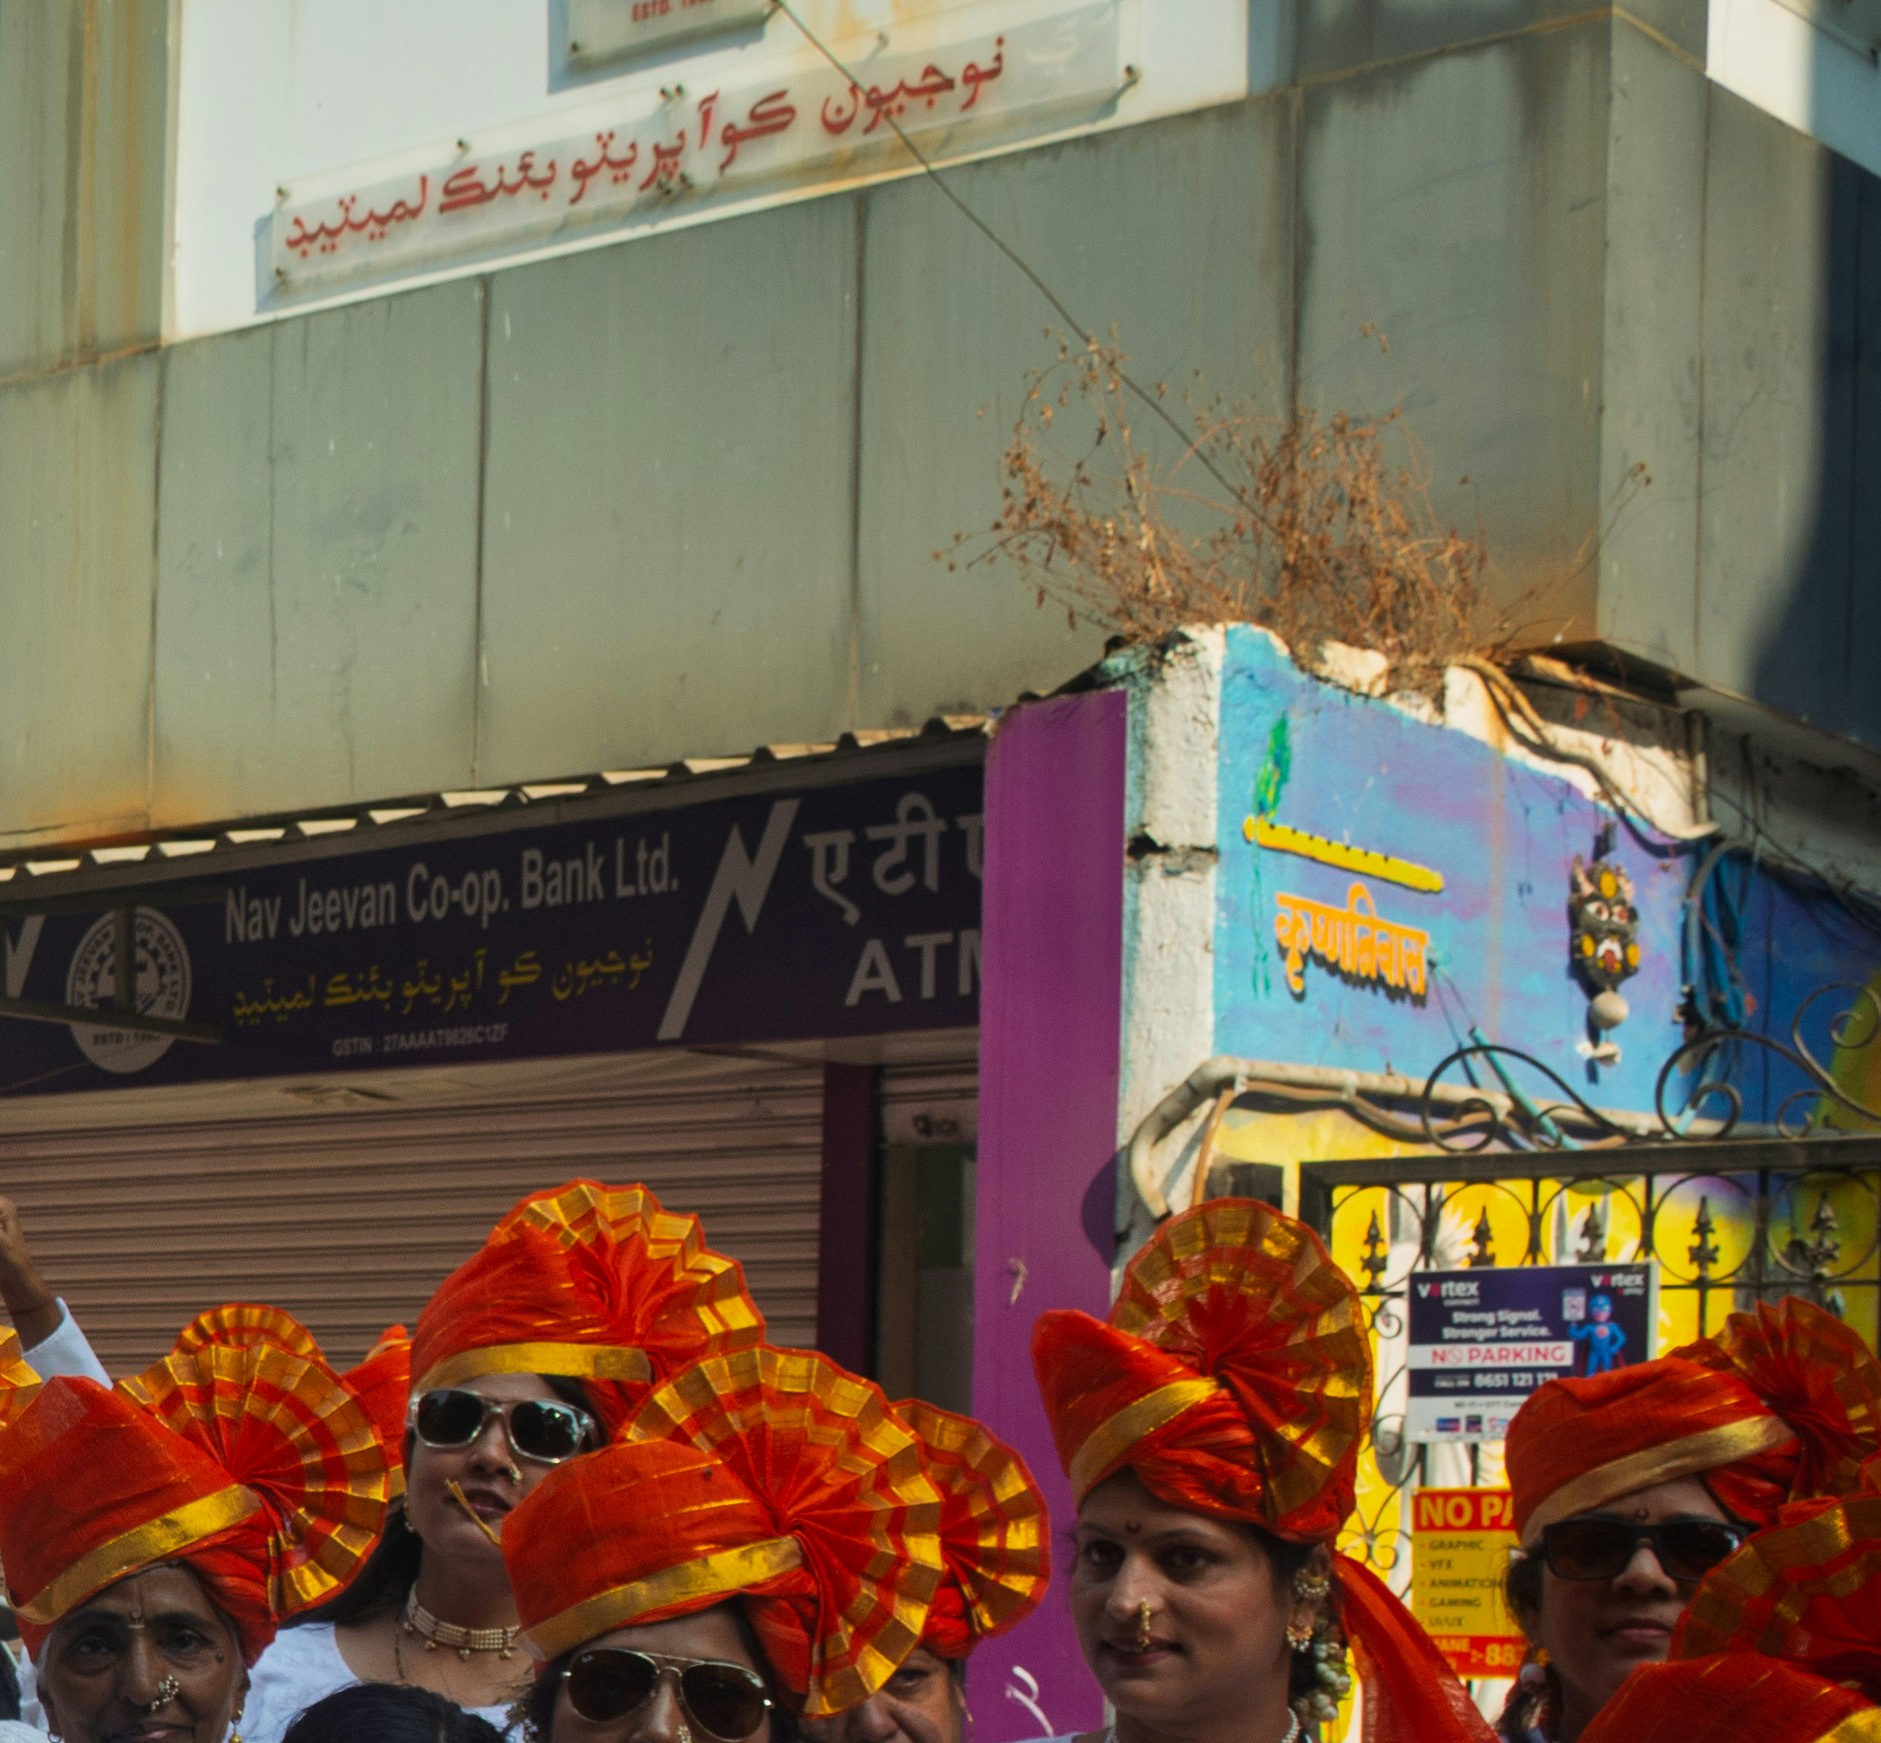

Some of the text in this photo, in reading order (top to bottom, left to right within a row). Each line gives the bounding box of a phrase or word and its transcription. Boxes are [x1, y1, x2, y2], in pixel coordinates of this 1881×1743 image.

[224, 832, 679, 945] Nav Jeevan Co-op. Bank Ltd.
[1468, 1345, 1566, 1363] PARKING
[1419, 1496, 1473, 1527] NO
